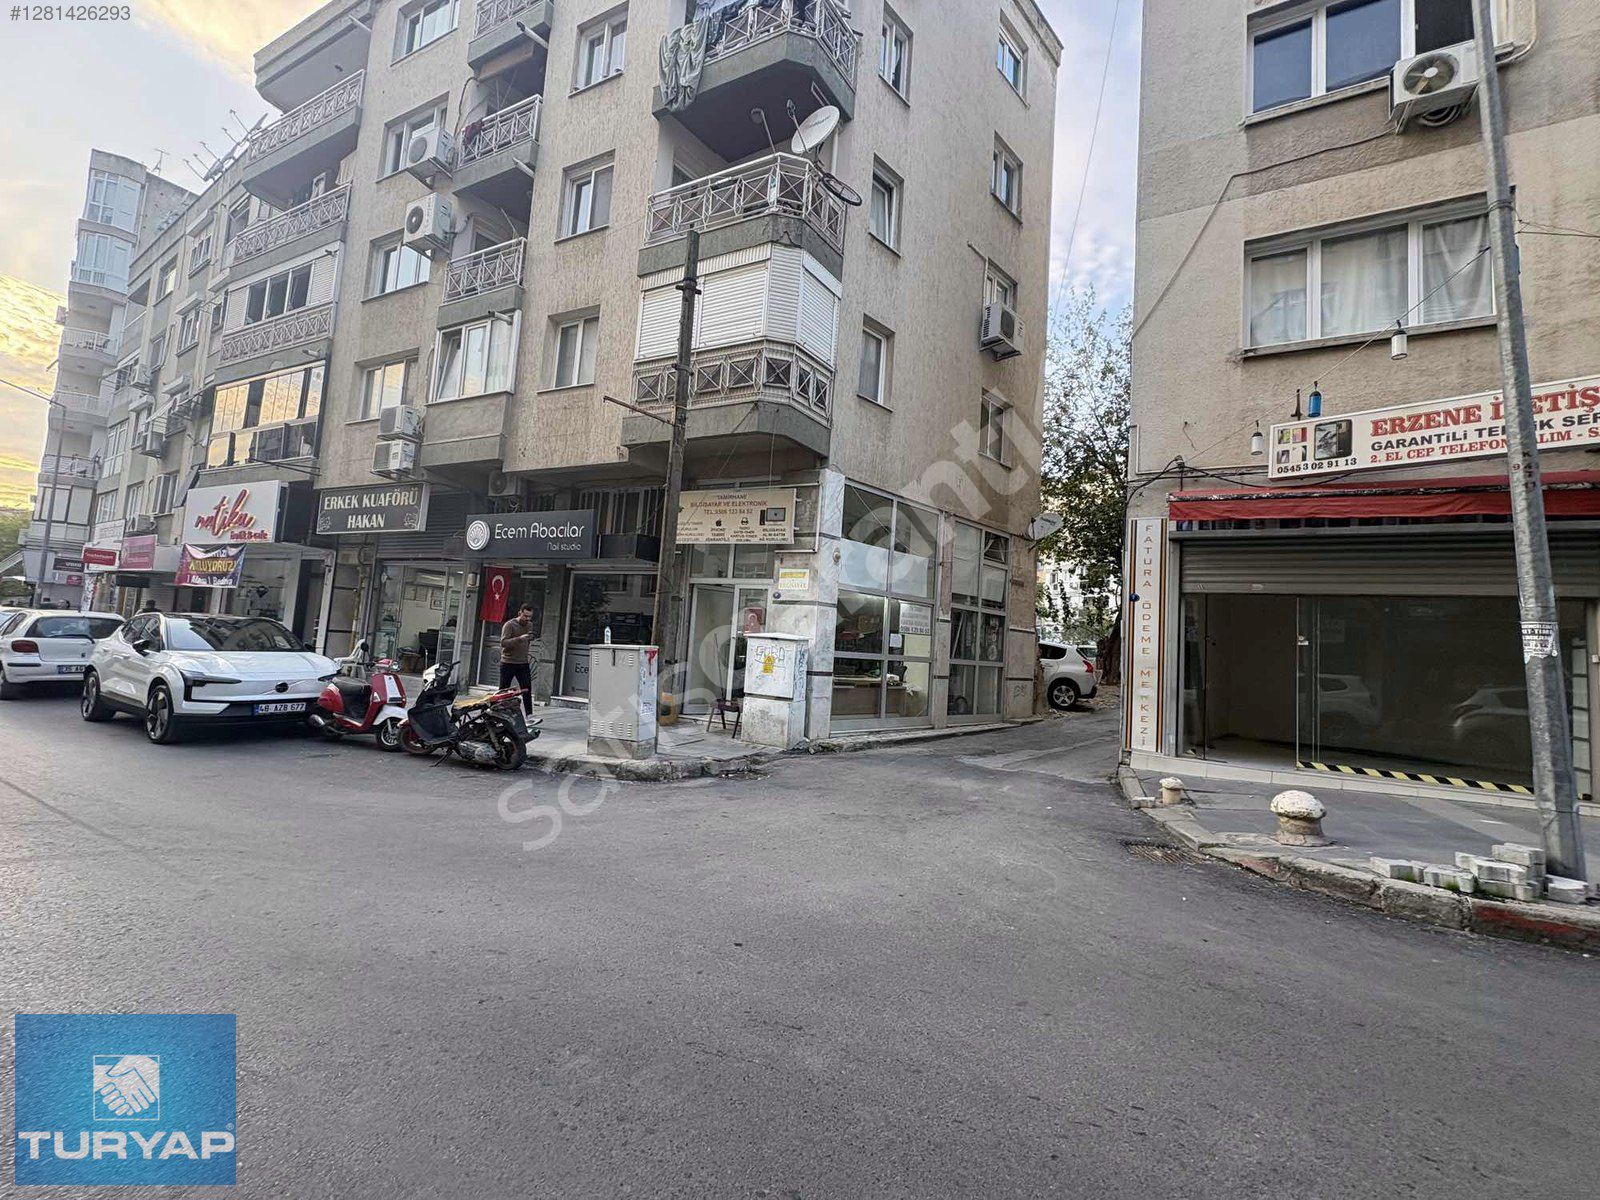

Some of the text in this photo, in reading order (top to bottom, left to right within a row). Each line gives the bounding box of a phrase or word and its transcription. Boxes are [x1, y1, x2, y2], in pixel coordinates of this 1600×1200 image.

[1370, 383, 1600, 437] ERZENE İETİŞ
[1474, 418, 1554, 438] TEiK
[1385, 452, 1403, 462] EL
[1406, 447, 1435, 461] CEP
[1536, 430, 1572, 444] LIM
[1588, 426, 1600, 438] S
[1344, 457, 1358, 466] 13
[324, 487, 417, 511] ERKEK KUAFÖRÜ
[347, 513, 385, 529] HAKAN
[494, 521, 585, 539] Ecem Abacılar
[546, 542, 582, 551] Nail studio
[1143, 524, 1153, 588] FATURA
[1141, 600, 1151, 655] ÖDEME
[575, 664, 589, 674] Ece
